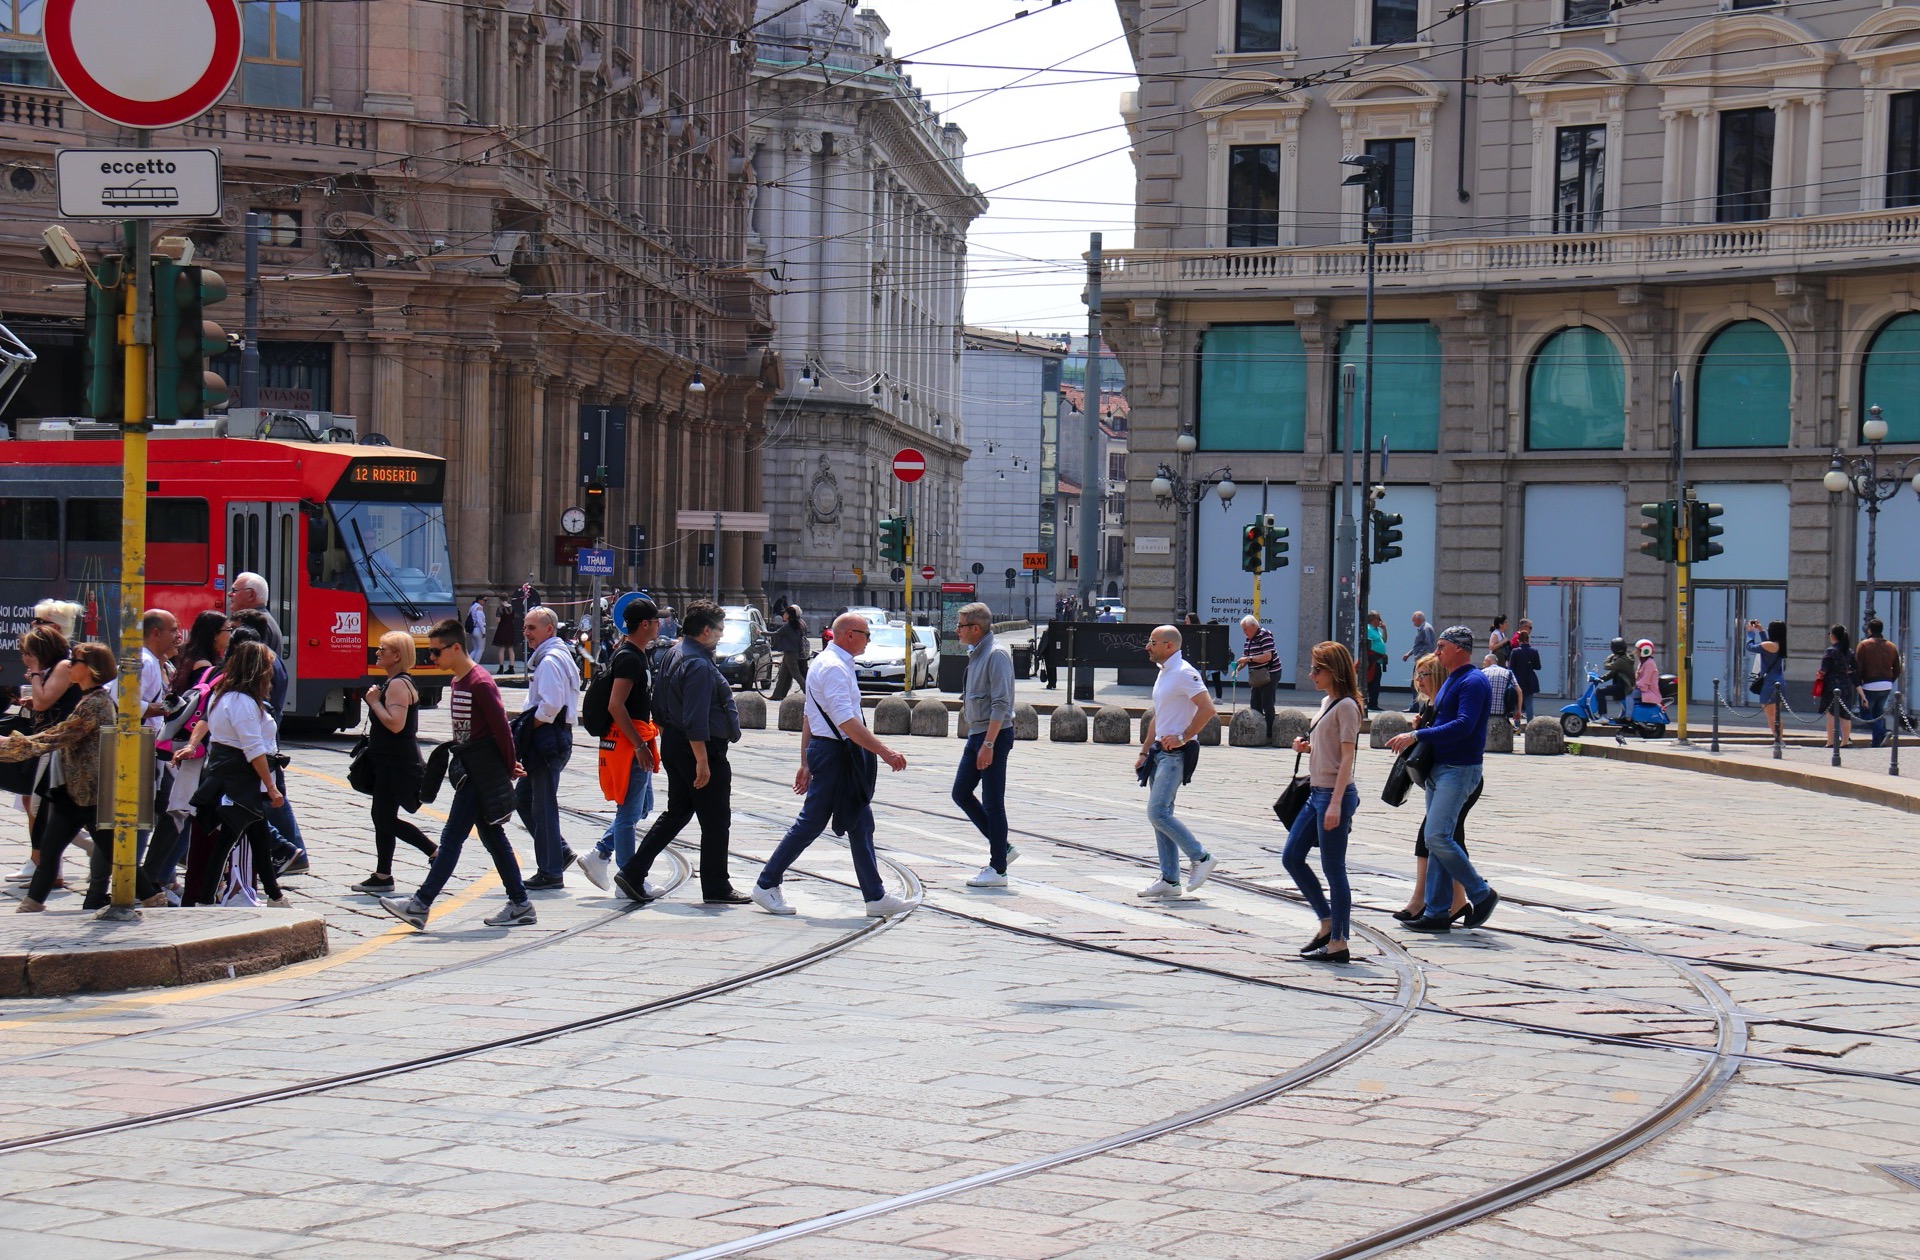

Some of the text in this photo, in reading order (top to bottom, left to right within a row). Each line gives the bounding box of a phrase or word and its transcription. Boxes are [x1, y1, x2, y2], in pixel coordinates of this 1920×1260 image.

[101, 159, 176, 174] eccetto
[231, 389, 310, 401] AIVIAMO
[356, 468, 417, 482] 12 ROSERIO
[586, 555, 607, 566] TRAM
[1024, 557, 1046, 566] TAXI
[1211, 596, 1268, 606] Essential appel
[1211, 606, 1255, 616] for every day
[344, 614, 359, 629] 40
[331, 635, 361, 644] Comitato
